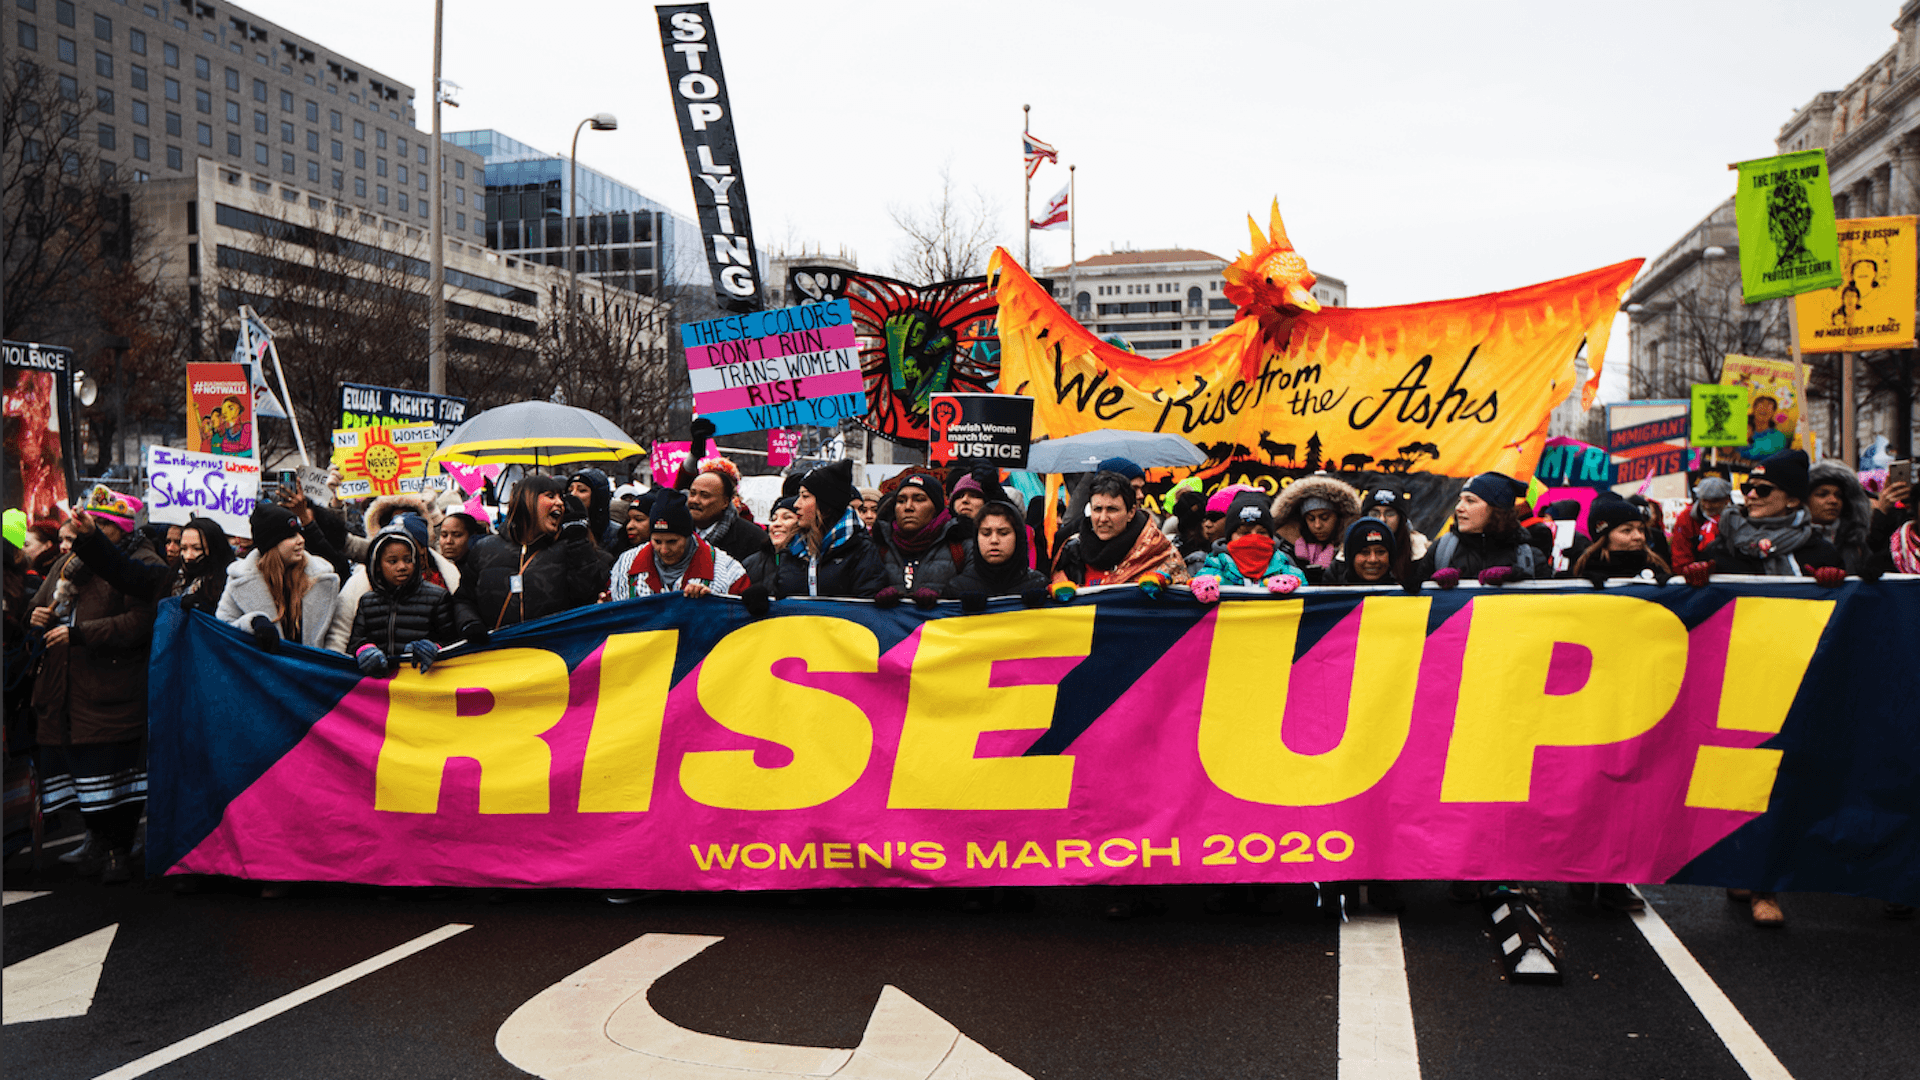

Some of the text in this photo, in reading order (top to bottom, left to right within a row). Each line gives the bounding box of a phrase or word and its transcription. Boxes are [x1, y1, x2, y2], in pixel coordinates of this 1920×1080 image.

[671, 12, 755, 296] STOP LYING
[689, 302, 842, 345] THESE COLORS
[707, 329, 831, 367] DON'T RUN.
[714, 349, 850, 389] TRANS WOMEN
[747, 379, 805, 406] RISE
[1053, 340, 1135, 421] We
[1151, 374, 1247, 433] Rise
[1251, 354, 1321, 409] from
[1287, 387, 1349, 416] the
[343, 387, 382, 413] EQUAL
[390, 393, 435, 418] RIGHTS
[438, 399, 465, 421] FOR
[746, 394, 857, 430] WITH YOU!
[338, 434, 356, 446] NM
[393, 429, 440, 442] WOMEN
[948, 423, 1016, 434] Jewish Women
[948, 432, 993, 441] march for
[1611, 418, 1686, 448] IMMIGRANT
[367, 457, 397, 468] NEVER
[948, 442, 1021, 459] JUSTICE
[1617, 452, 1681, 483] RIGHTS
[341, 482, 369, 493] STOP
[375, 595, 1835, 813] RISE UP!
[691, 832, 1354, 869] WOMEN'S MARCH 2020
